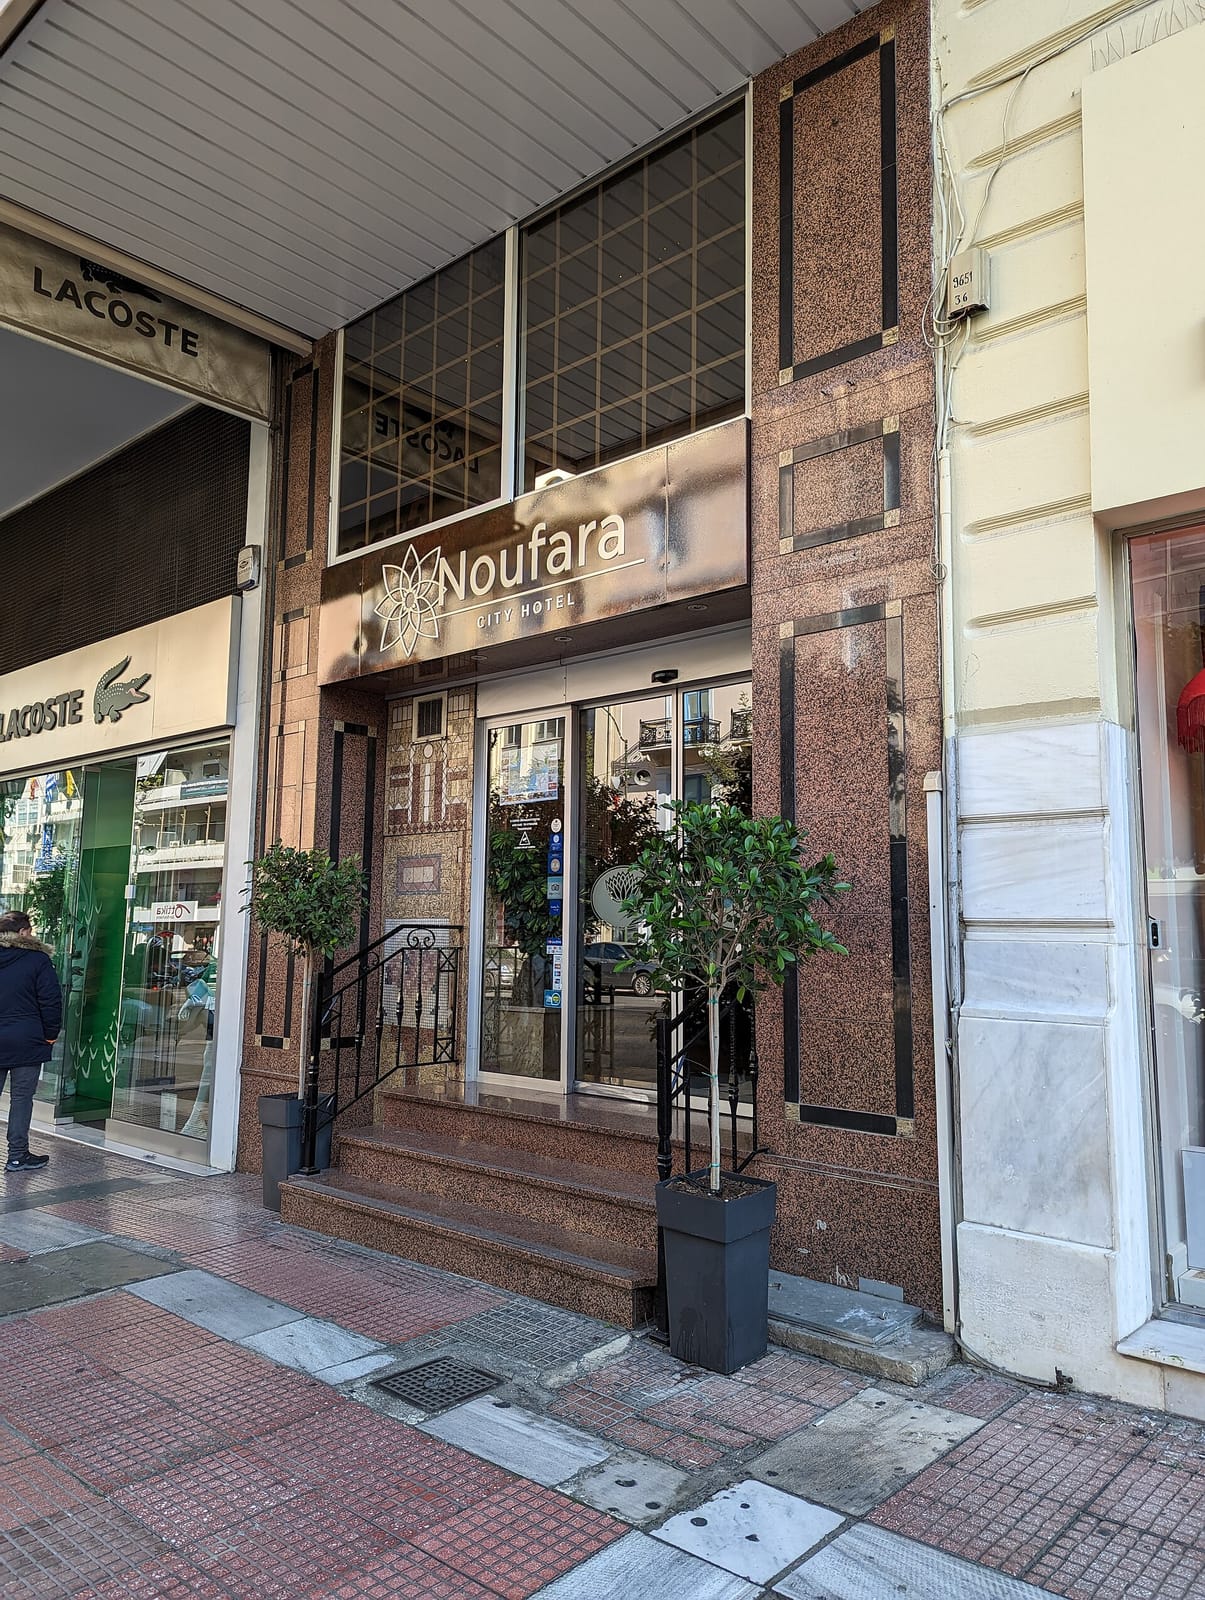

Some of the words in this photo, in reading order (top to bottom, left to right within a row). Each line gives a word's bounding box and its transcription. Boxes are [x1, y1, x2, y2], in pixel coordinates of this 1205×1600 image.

[33, 266, 199, 357] LACOSTE
[952, 271, 973, 289] 9651
[439, 514, 626, 606] Noufara
[477, 606, 513, 628] CITY
[521, 593, 575, 618] HOTEL
